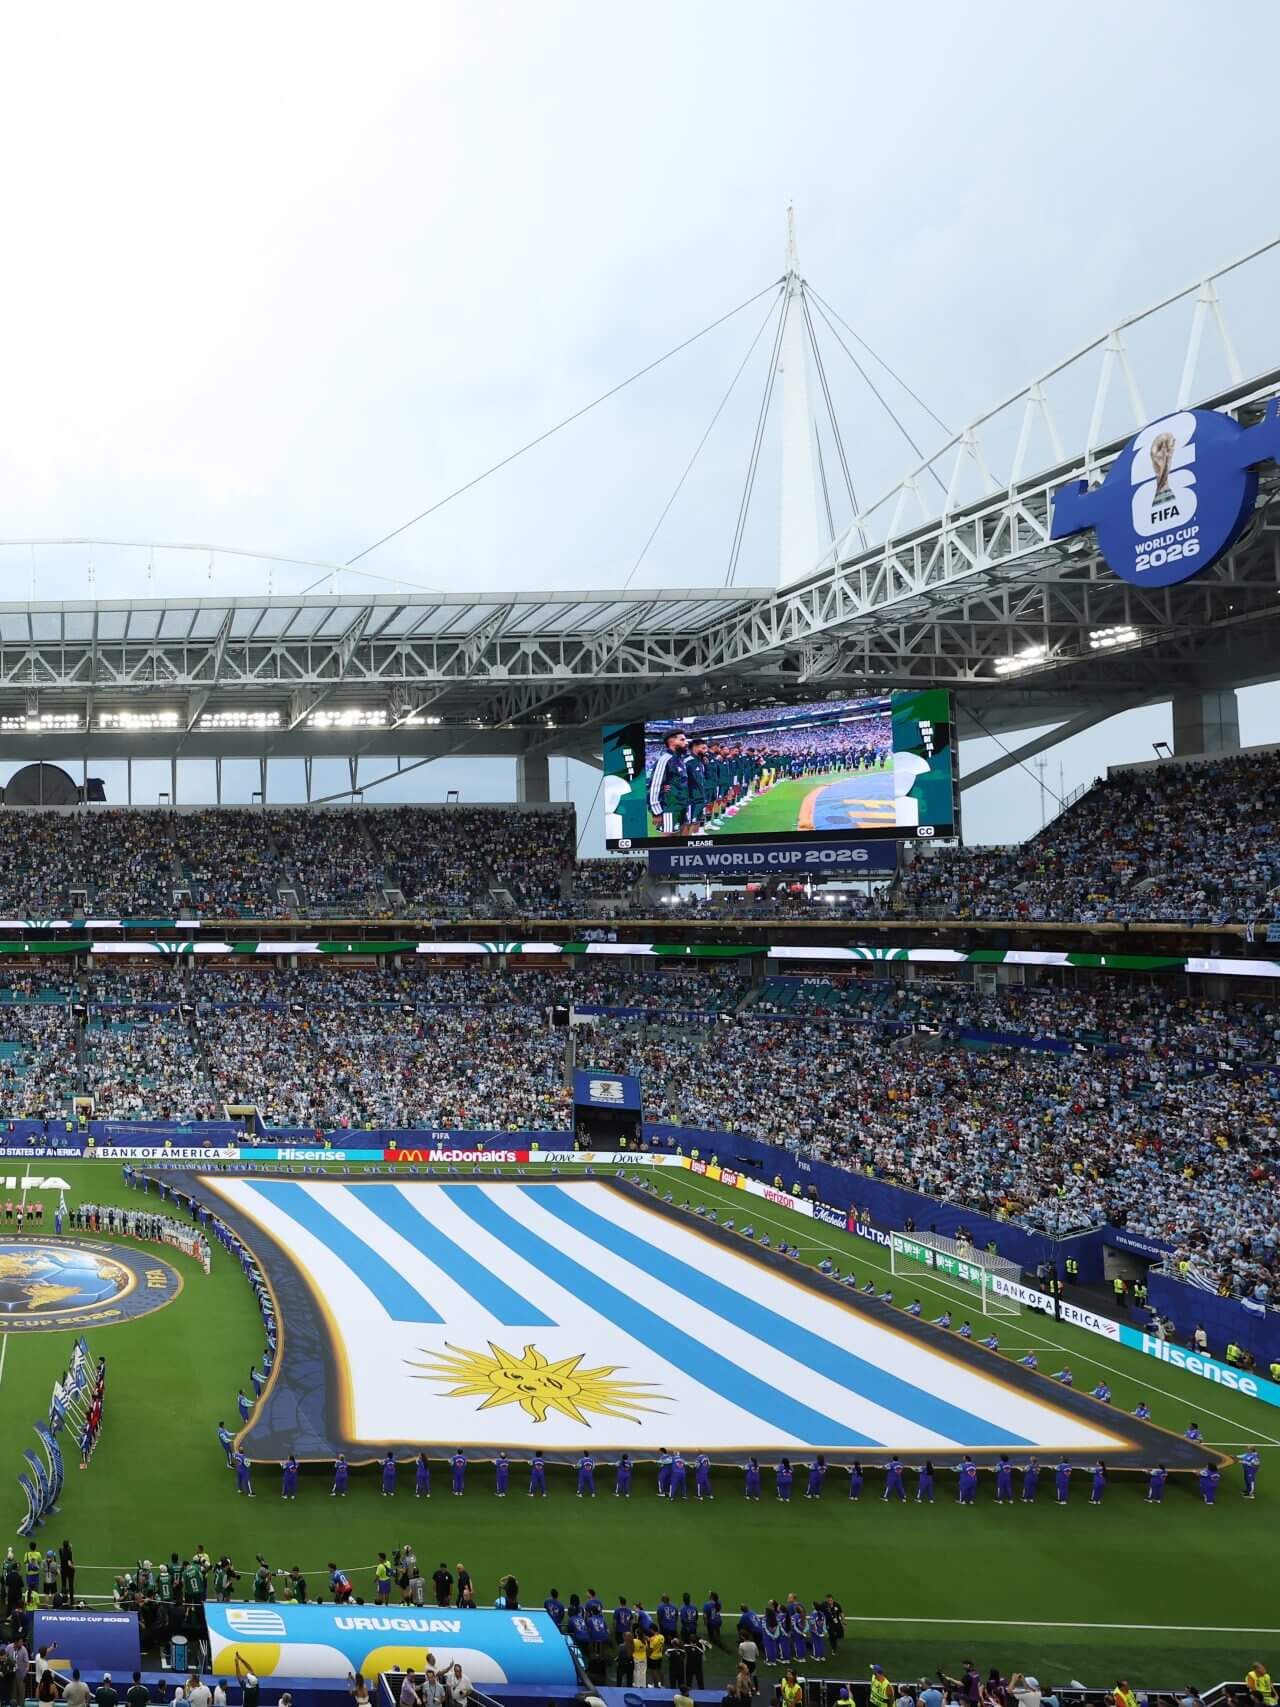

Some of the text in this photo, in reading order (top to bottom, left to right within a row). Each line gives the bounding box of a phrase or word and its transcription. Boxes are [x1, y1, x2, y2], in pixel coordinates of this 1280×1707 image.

[1151, 506, 1179, 524] FIFA
[1135, 526, 1199, 554] WORLD CUP
[1135, 539, 1200, 572] 2026
[670, 849, 869, 867] FIFA WORLD CUP 2026
[431, 1132, 450, 1140] FIFA
[7, 1147, 34, 1156] STATES
[37, 1148, 46, 1156] OF
[103, 1149, 220, 1158] BANK OF AMERICA
[277, 1149, 346, 1160] Hisense
[429, 1151, 516, 1162] McDonald's
[544, 1152, 575, 1163] Dove
[612, 1153, 644, 1164] Dove
[798, 1160, 811, 1173] FIFA
[763, 1187, 795, 1209] verizon
[814, 1206, 891, 1248] Michelob ULTRA
[1128, 1239, 1147, 1250] WORLD
[144, 1269, 168, 1288] FIFA
[996, 1280, 1025, 1300] BANK
[1028, 1292, 1043, 1306] OF
[12, 1319, 52, 1327] CUP
[56, 1309, 121, 1325] 2026
[1142, 1333, 1258, 1397] Hisense
[334, 1617, 461, 1633] URUGUAY
